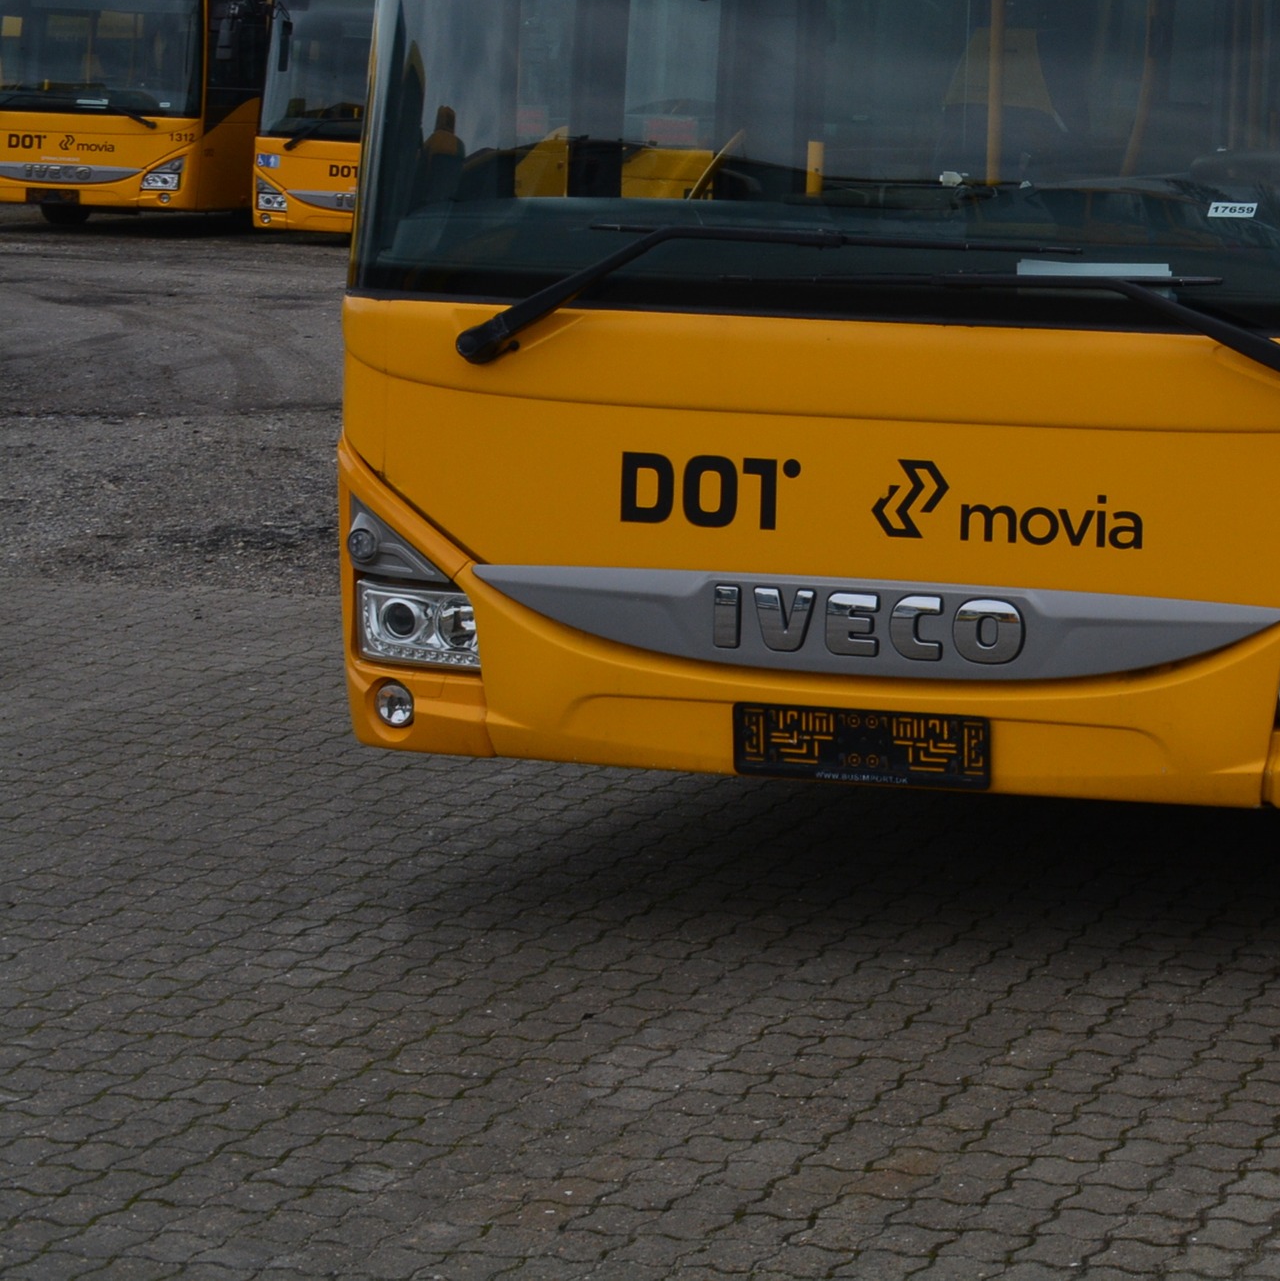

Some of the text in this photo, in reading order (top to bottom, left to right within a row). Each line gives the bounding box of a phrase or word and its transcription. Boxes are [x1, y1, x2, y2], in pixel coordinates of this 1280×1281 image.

[8, 133, 115, 153] DOT movia
[169, 132, 196, 143] 1312
[24, 164, 93, 180] IVECO
[1213, 205, 1254, 214] 17659
[620, 451, 1143, 550] DOT movia
[712, 583, 1027, 665] IVECO
[815, 769, 909, 785] WWW.BUSIMPORT.DK
